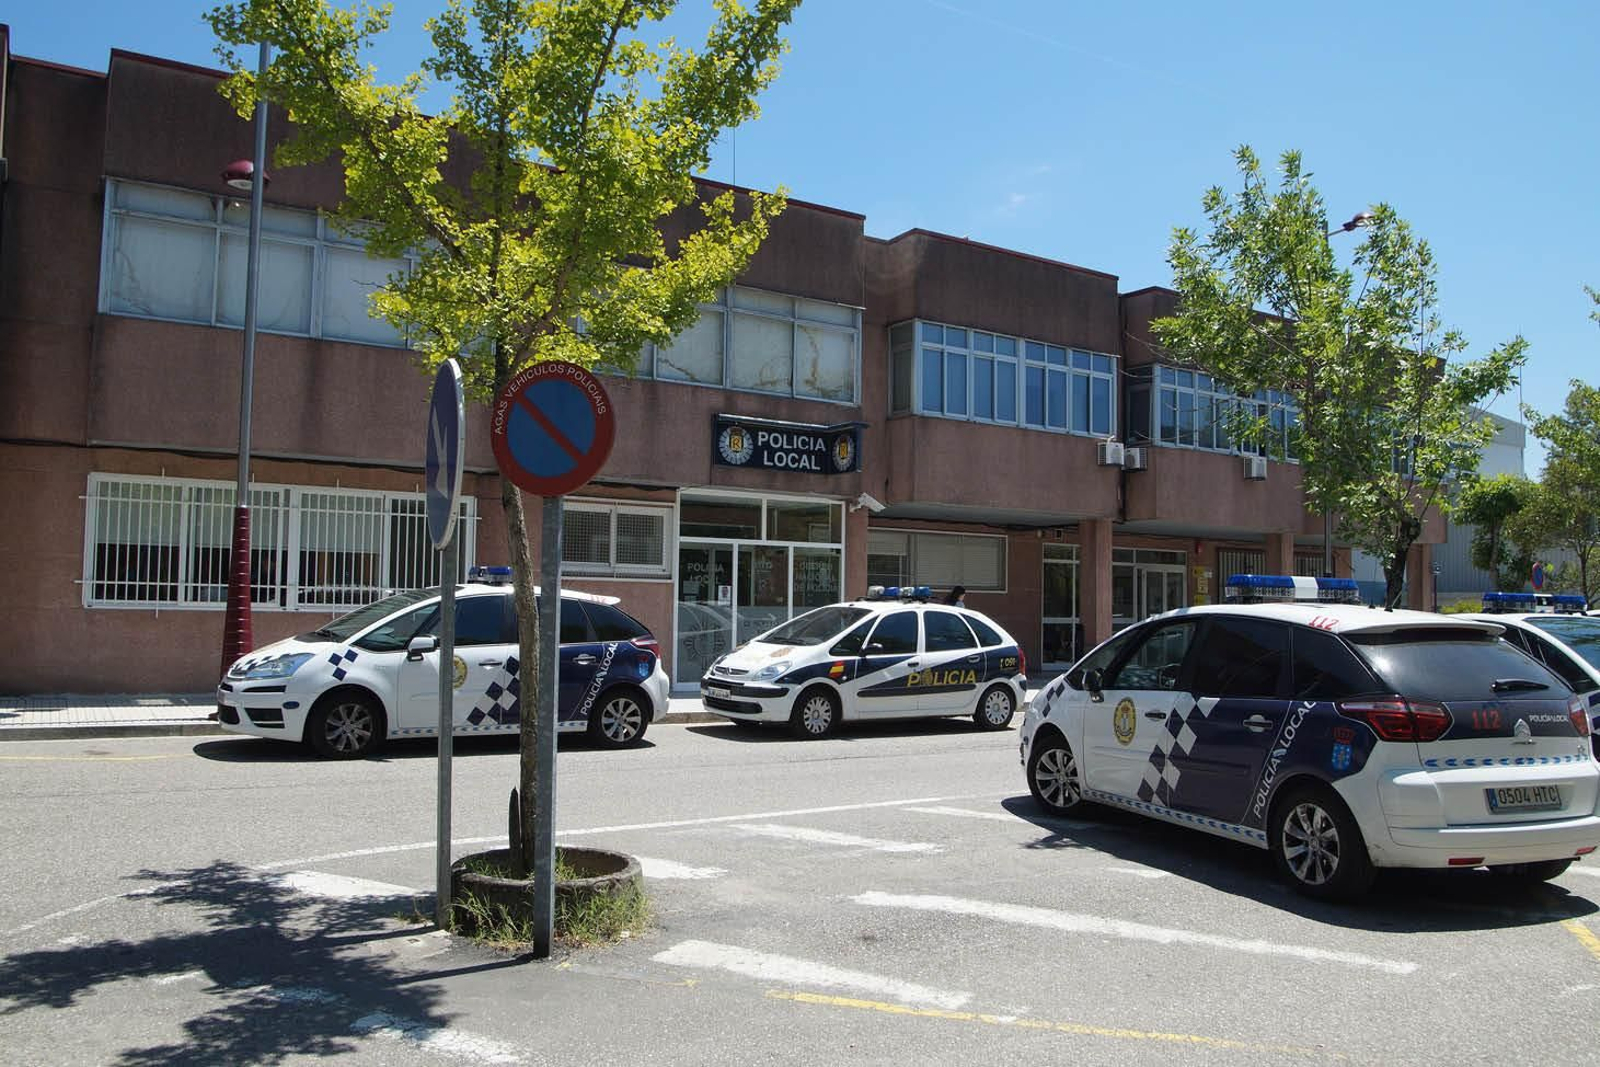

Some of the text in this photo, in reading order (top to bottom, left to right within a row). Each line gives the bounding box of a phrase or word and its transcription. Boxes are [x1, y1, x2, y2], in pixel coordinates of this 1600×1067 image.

[504, 363, 565, 399] VEHICULOS
[567, 366, 607, 414] POLICIAIS
[758, 431, 826, 451] POLICIA
[763, 451, 821, 470] LOCAL
[687, 561, 724, 573] POLIIA
[1309, 615, 1339, 631] 112
[600, 642, 619, 672] LOCAL
[1280, 700, 1316, 748] LOCAL
[1472, 709, 1501, 730] 112
[1498, 784, 1557, 805] 0504 HTC
